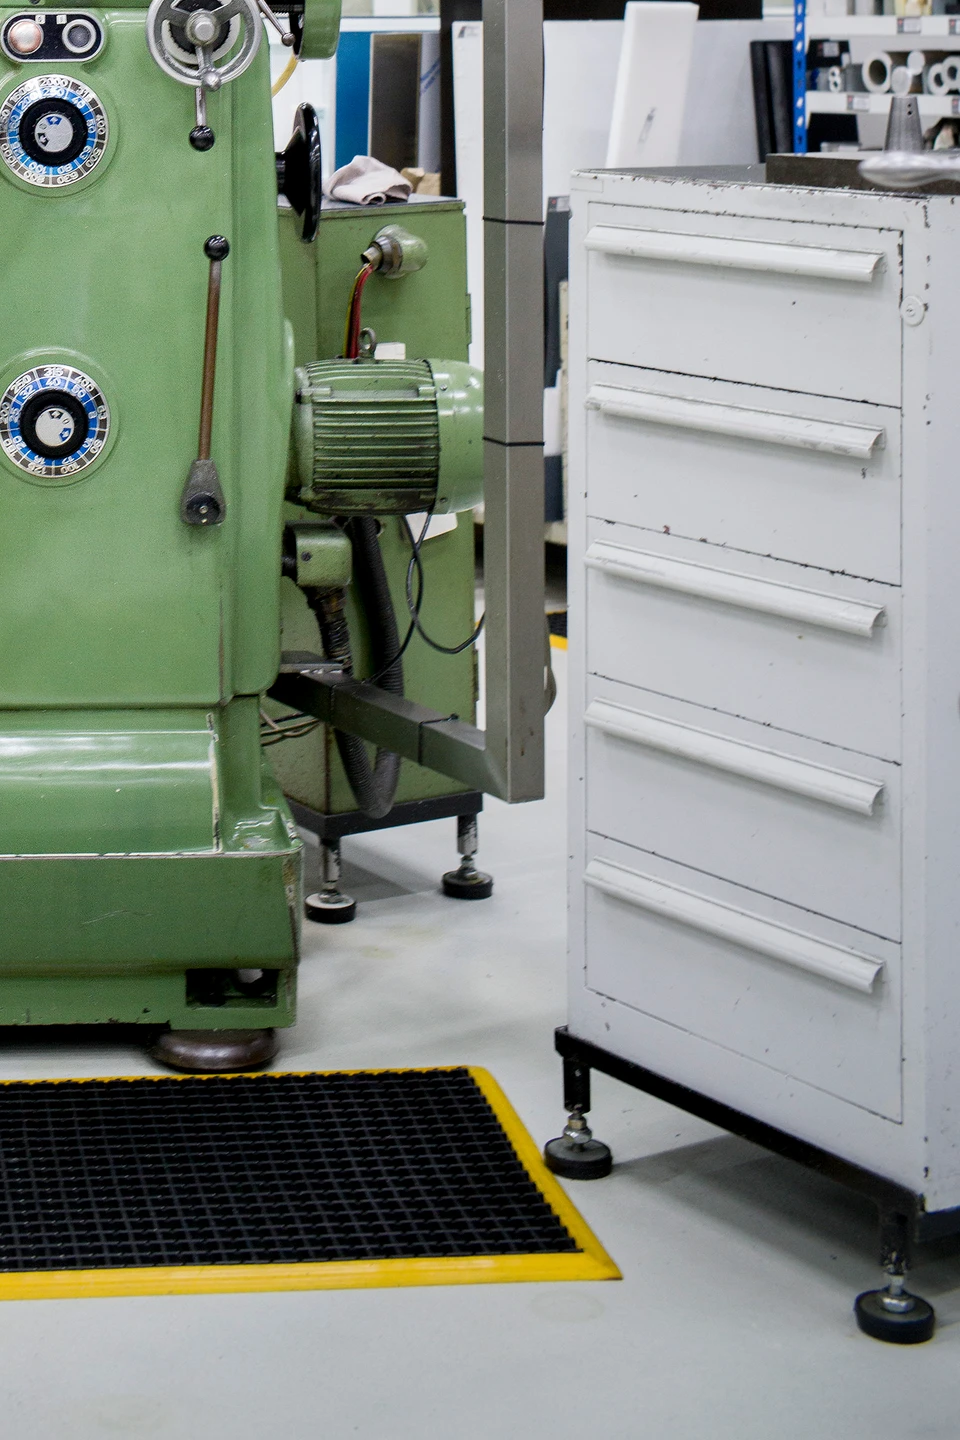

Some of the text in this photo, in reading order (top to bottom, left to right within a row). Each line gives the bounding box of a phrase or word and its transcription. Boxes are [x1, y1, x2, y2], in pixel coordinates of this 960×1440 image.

[41, 78, 68, 87] 2000
[72, 96, 85, 108] 40
[96, 114, 106, 135] 400
[0, 144, 18, 168] 1000
[80, 145, 92, 159] 63
[86, 148, 102, 168] 500
[28, 163, 46, 174] 100
[57, 165, 73, 174] 80
[56, 172, 79, 184] 630
[44, 368, 64, 377] 315
[10, 375, 32, 394] 250
[45, 378, 60, 386] 40
[75, 376, 94, 392] 400
[20, 384, 36, 400] 32
[12, 435, 27, 449] 20
[90, 438, 102, 454] 80
[60, 462, 80, 474] 100
